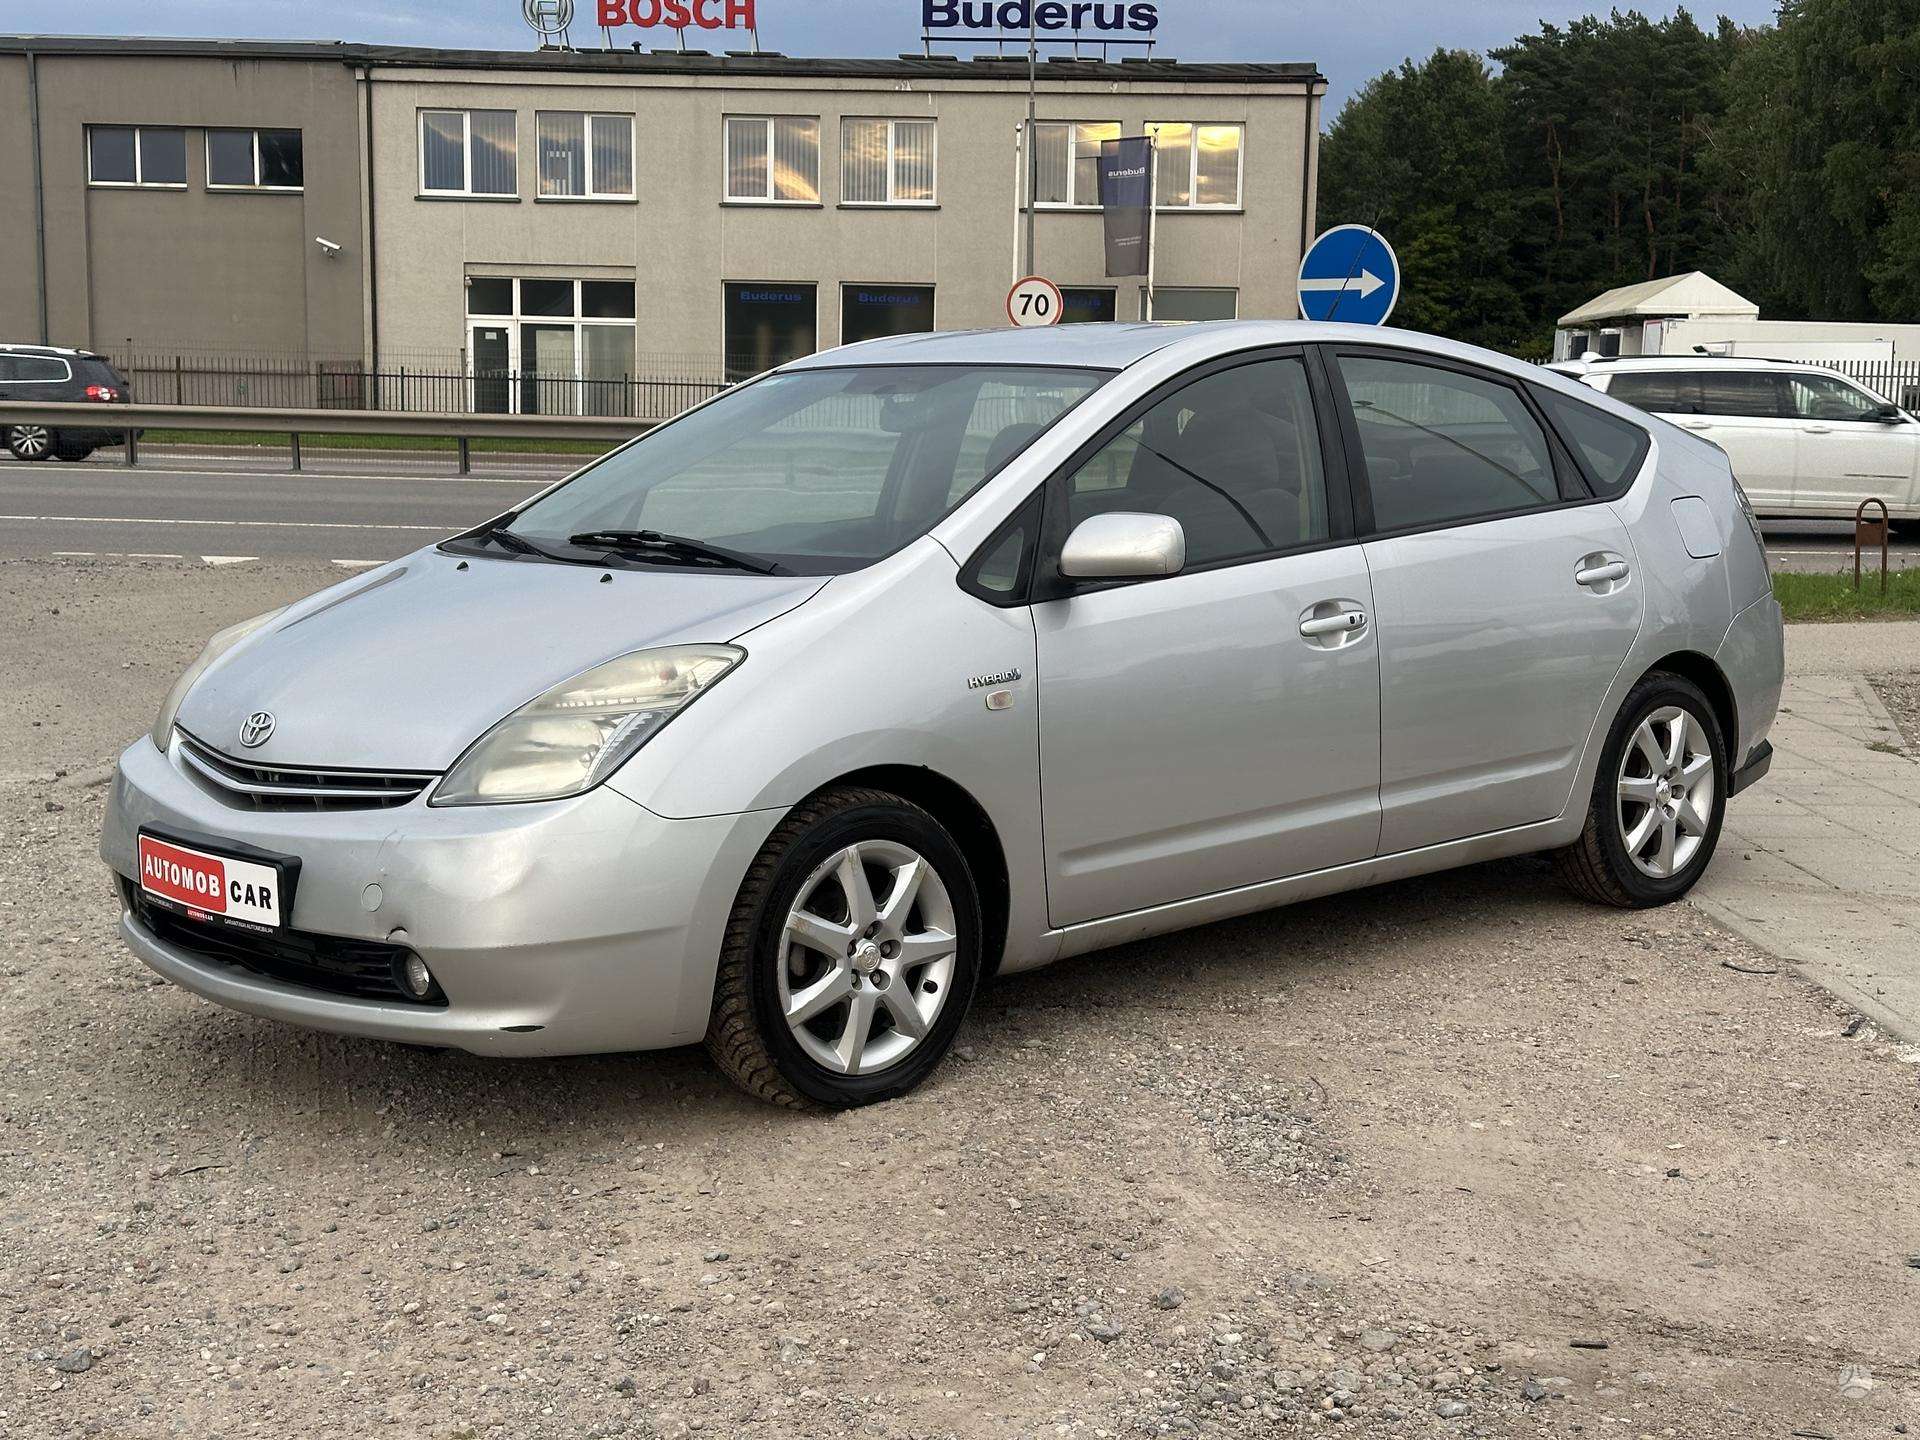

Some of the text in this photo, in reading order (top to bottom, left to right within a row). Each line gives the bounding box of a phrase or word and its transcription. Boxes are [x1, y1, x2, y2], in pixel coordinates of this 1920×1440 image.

[598, 0, 754, 29] BOSCH
[922, 0, 1159, 31] Buderus
[740, 291, 801, 302] Buderus
[1019, 293, 1049, 316] 70
[968, 671, 1014, 689] HYBRID
[145, 854, 272, 910] AUTOMOB CAR
